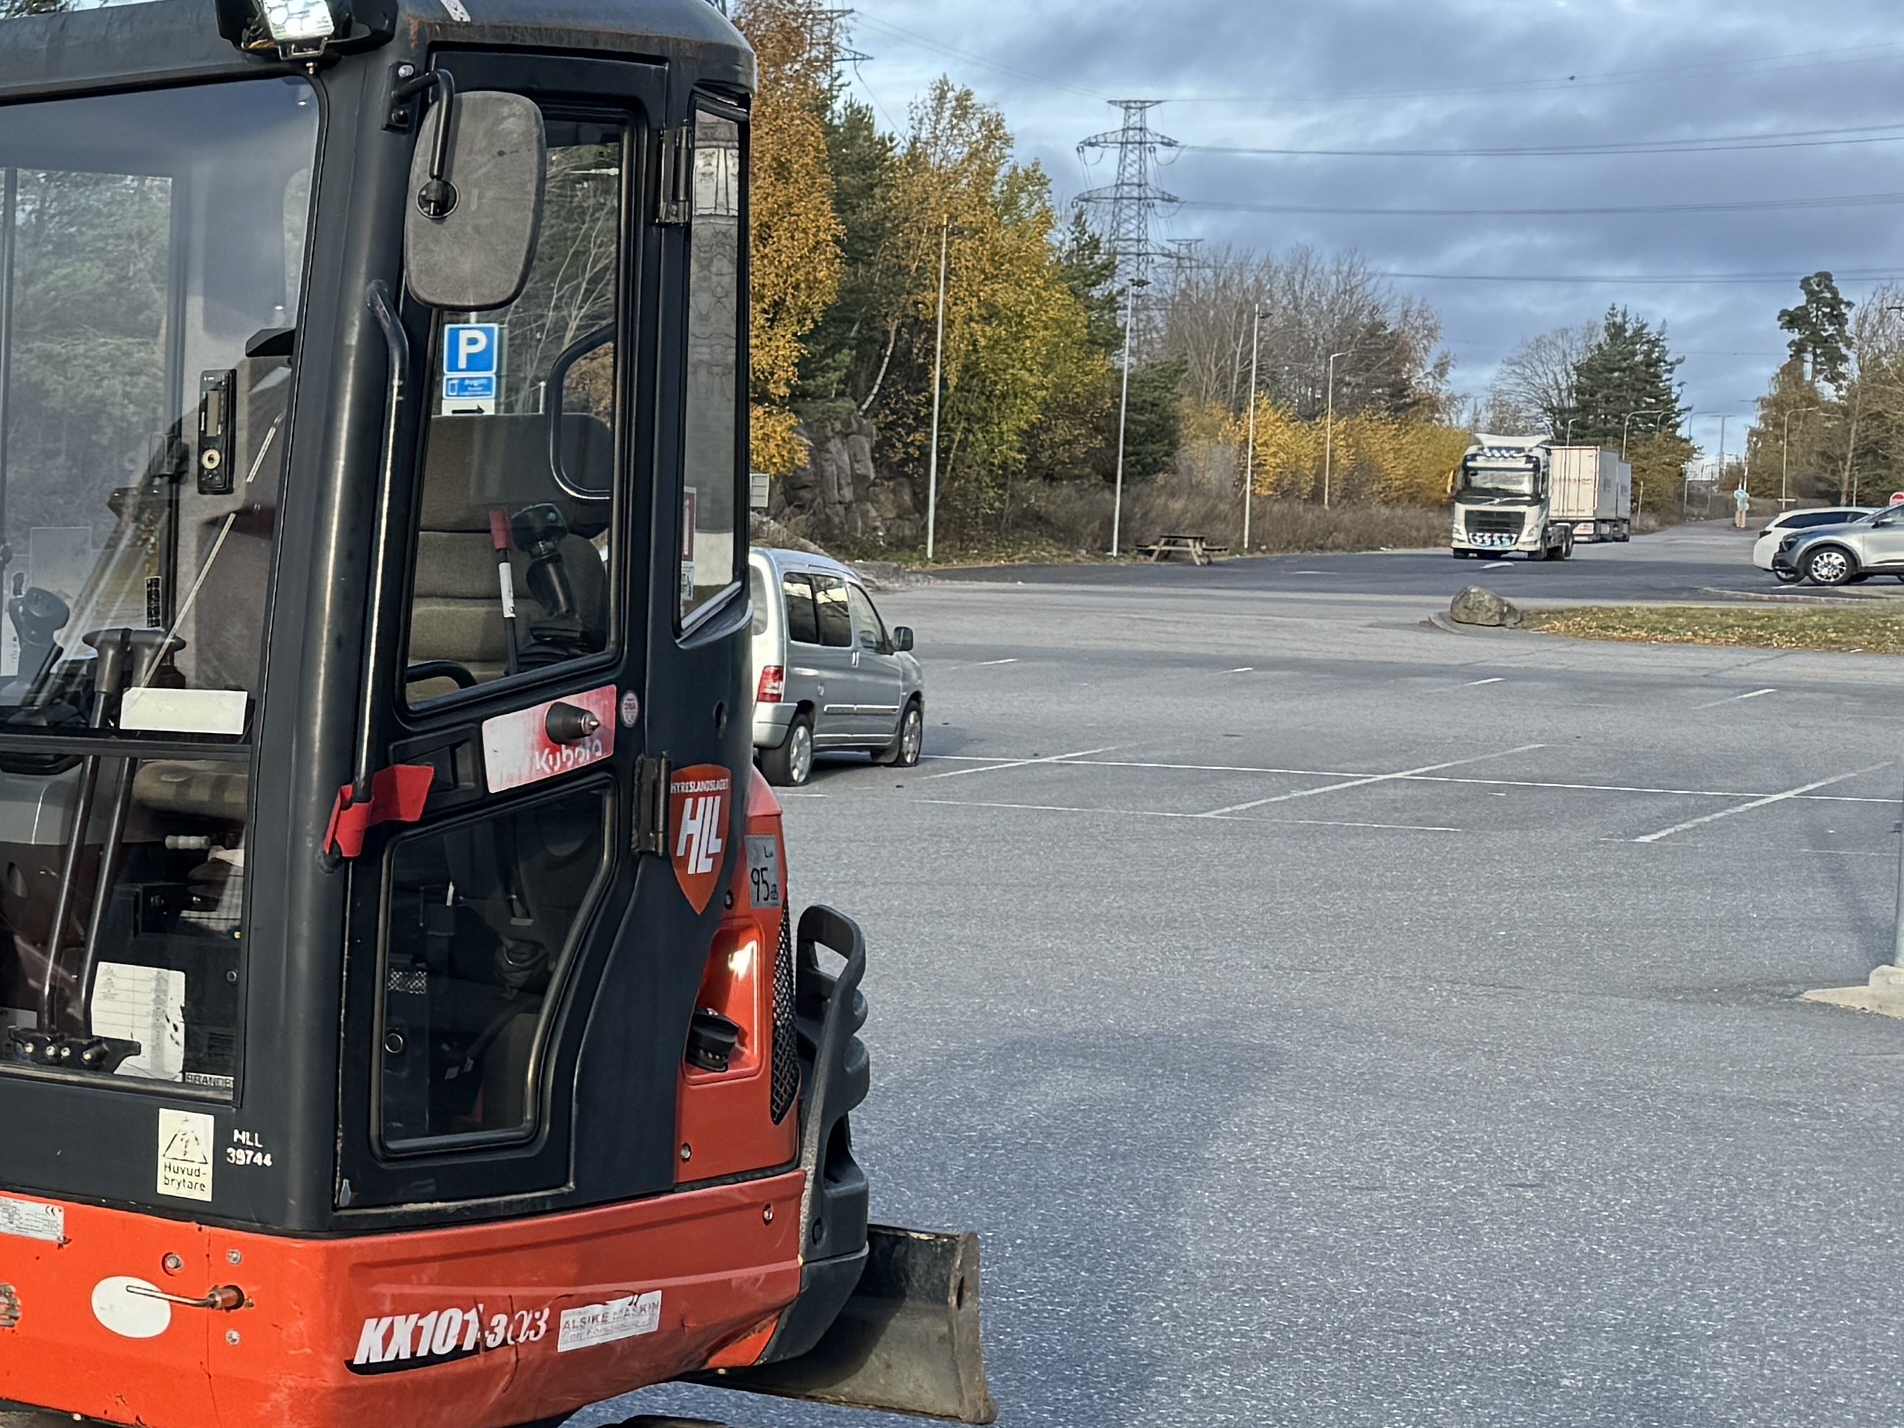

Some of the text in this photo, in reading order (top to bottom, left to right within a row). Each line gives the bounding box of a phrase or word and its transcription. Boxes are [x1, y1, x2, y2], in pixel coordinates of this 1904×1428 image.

[457, 329, 488, 369] P
[163, 1161, 207, 1178] Huvud-
[163, 1175, 206, 1192] brytare
